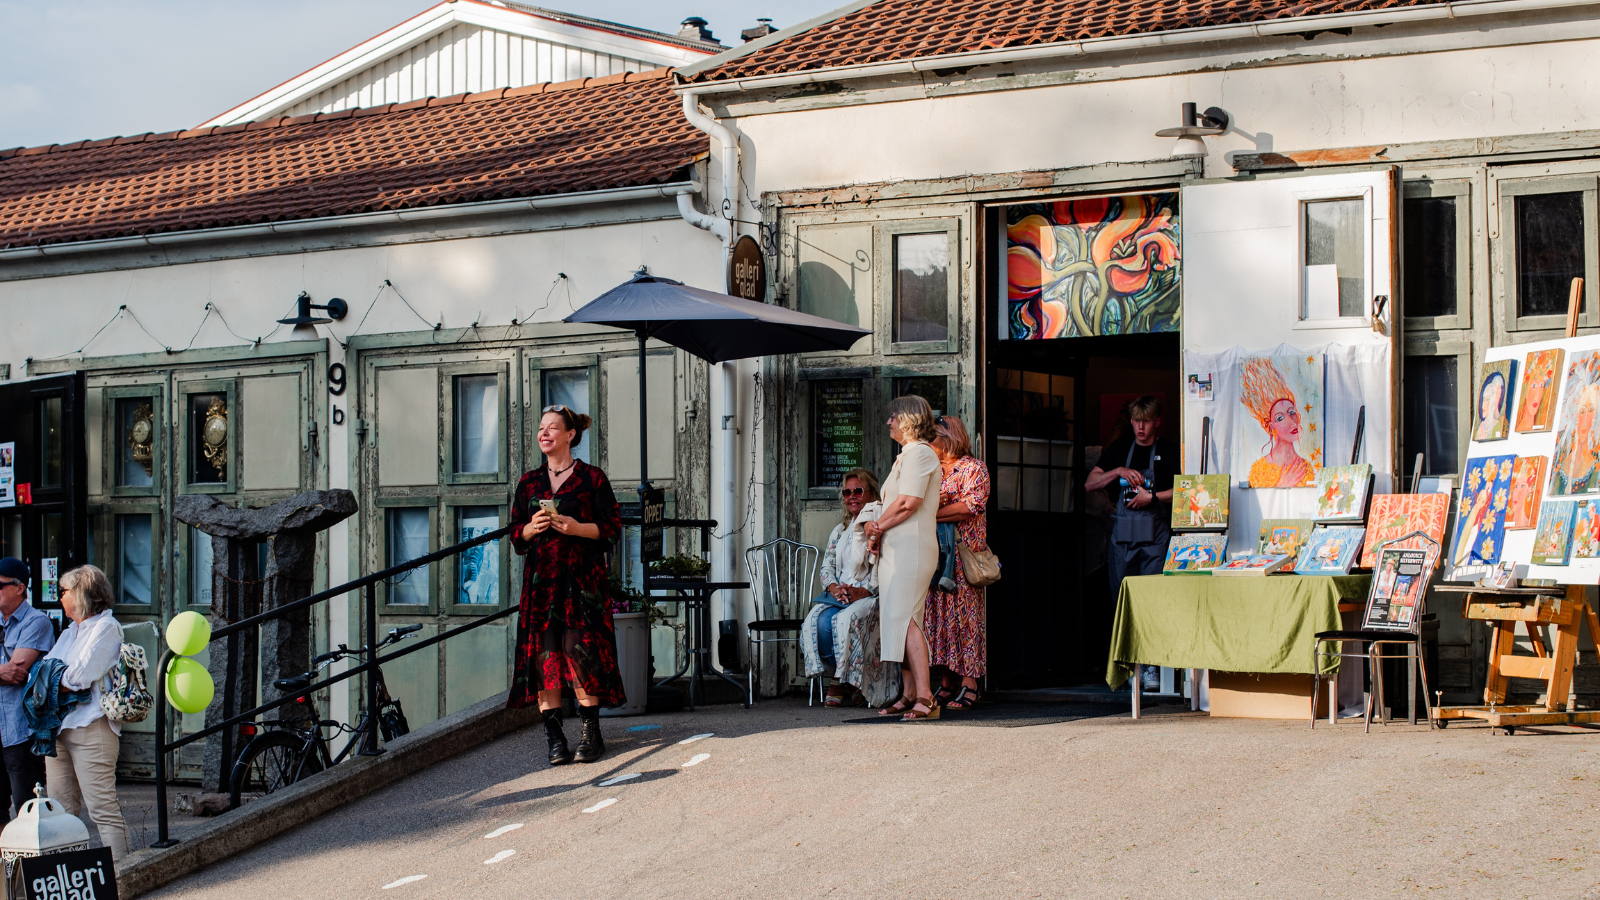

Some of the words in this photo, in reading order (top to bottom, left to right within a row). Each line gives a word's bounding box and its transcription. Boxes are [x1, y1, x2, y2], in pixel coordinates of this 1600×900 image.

[735, 257, 759, 284] galleri
[328, 362, 347, 396] 9
[332, 404, 345, 425] b
[644, 499, 664, 524] ÖPPET
[33, 861, 105, 900] galleri
